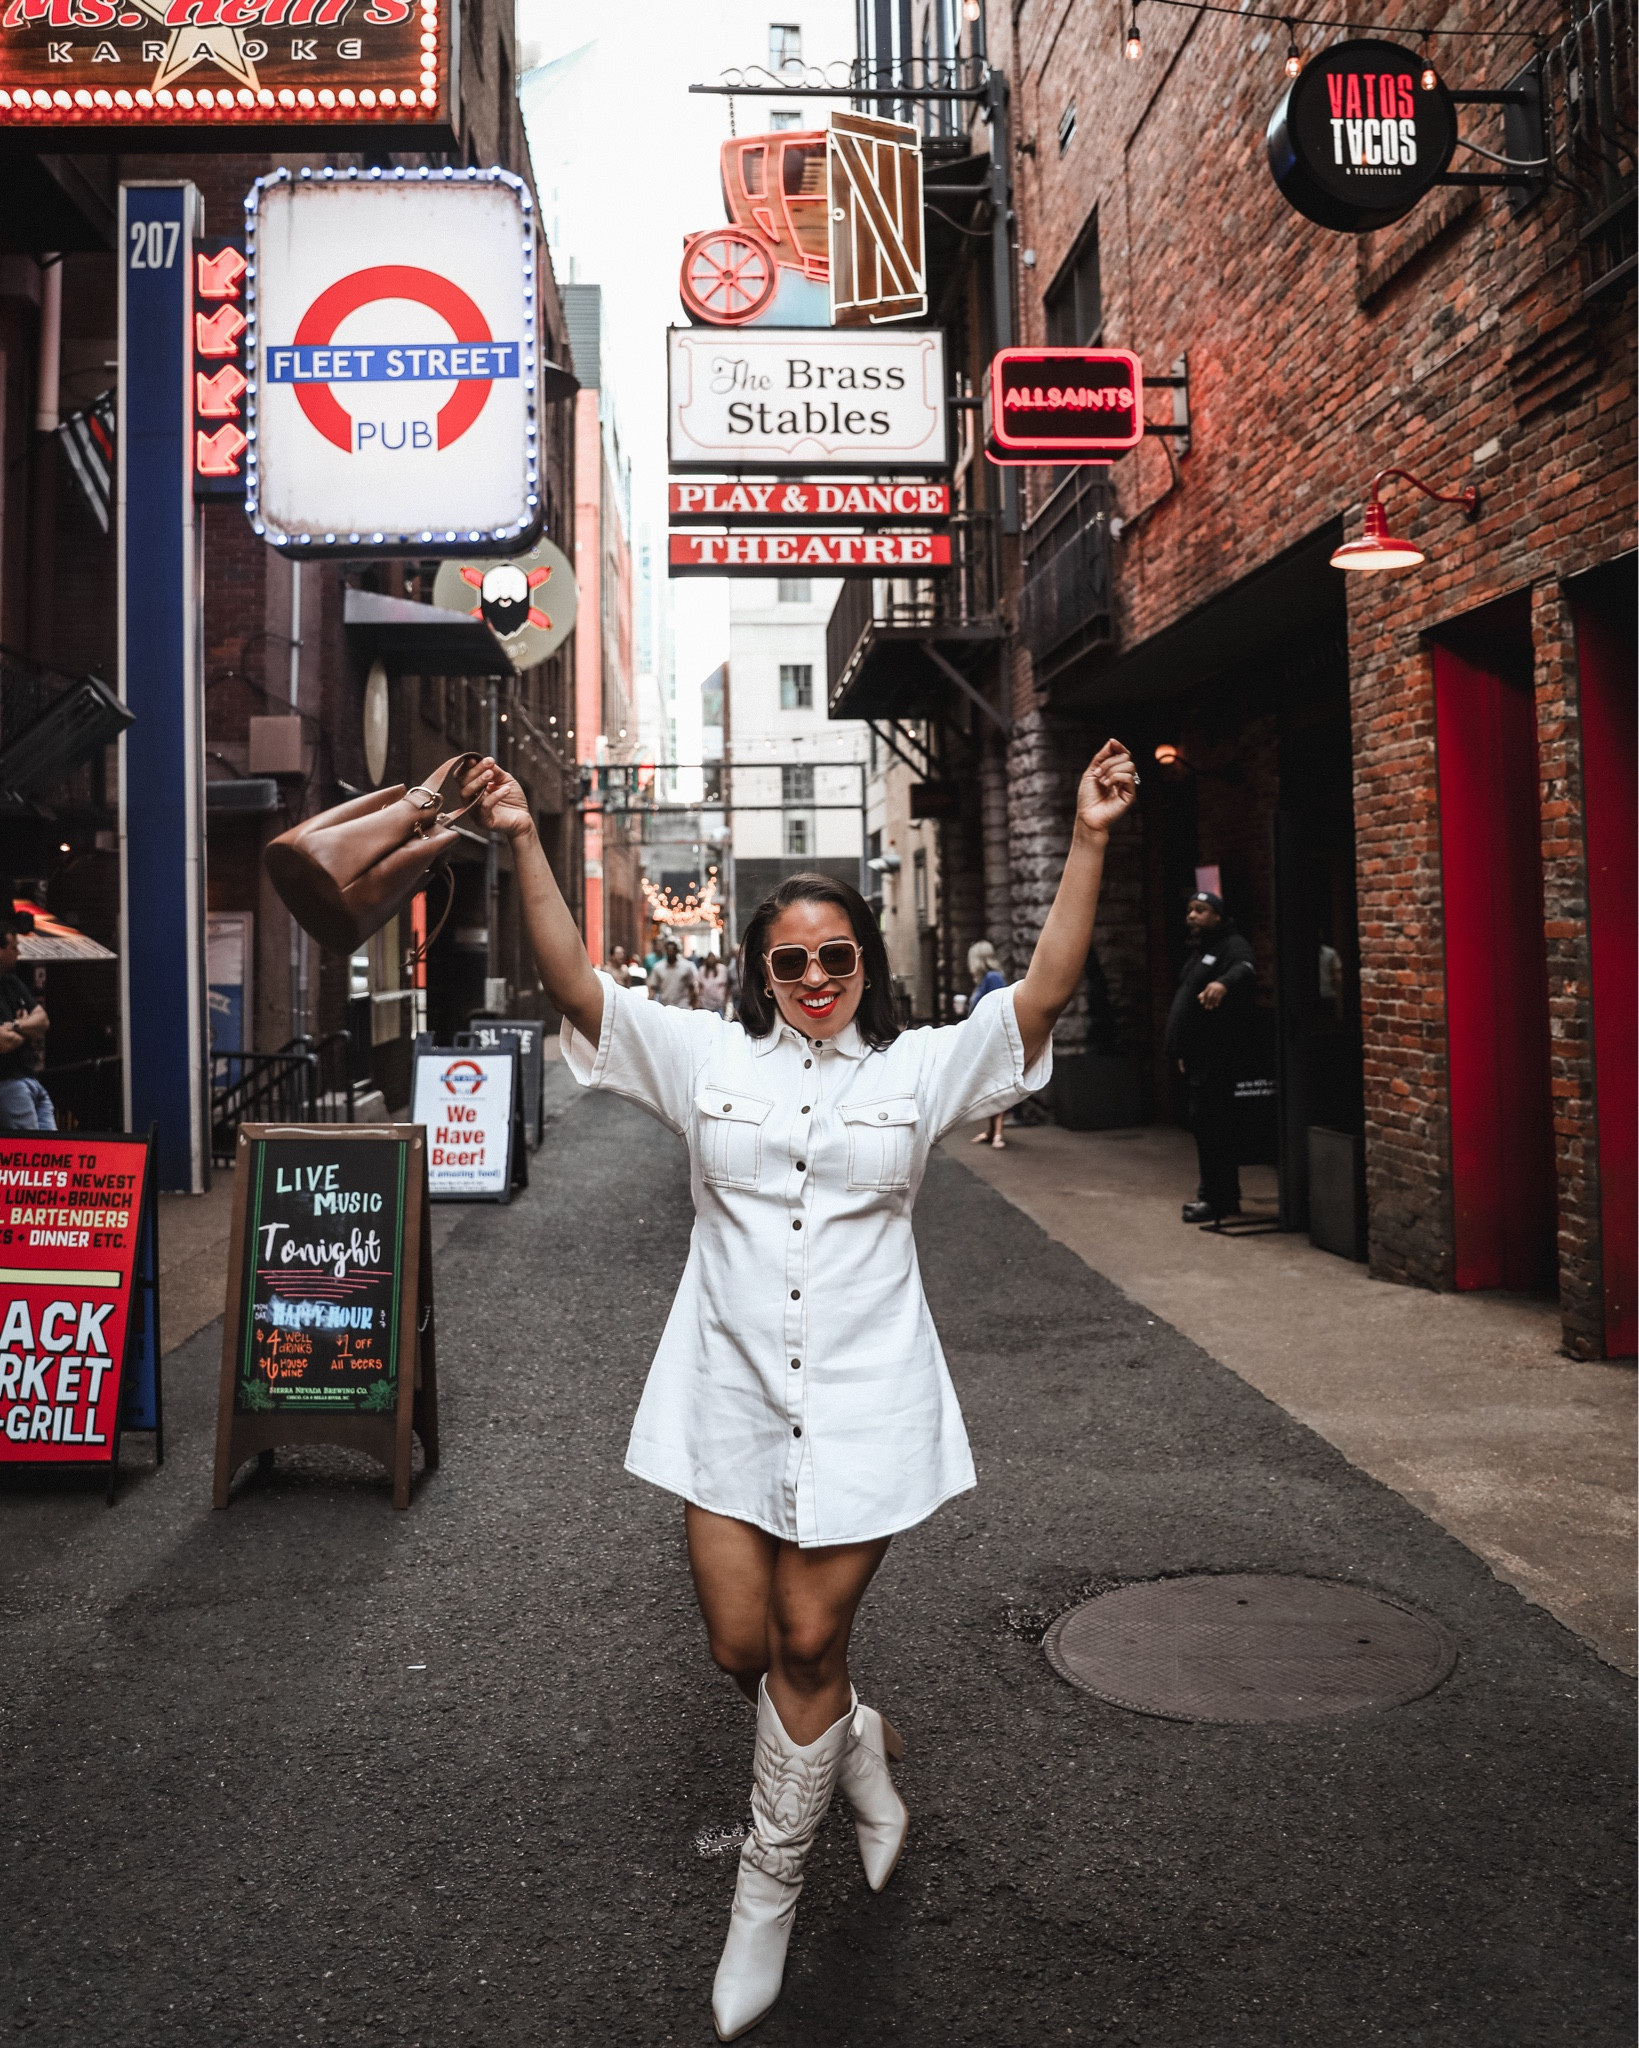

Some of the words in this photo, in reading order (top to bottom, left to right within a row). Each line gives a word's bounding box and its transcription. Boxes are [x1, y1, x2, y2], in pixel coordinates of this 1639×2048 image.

[48, 39, 362, 63] KARAOKE
[1326, 73, 1415, 119] VATOS
[1330, 118, 1417, 166] TACOS
[130, 221, 181, 269] 207
[273, 351, 376, 379] FLEET
[385, 347, 513, 378] STREET
[709, 356, 773, 395] The
[785, 358, 905, 390] Brass
[1003, 386, 1134, 410] ALLSAINTS
[727, 402, 891, 435] Stables
[357, 421, 433, 450] PUB
[677, 485, 775, 513] PLAY
[780, 485, 809, 513] &
[815, 485, 944, 514] DANCE
[690, 536, 933, 564] THEATRE
[447, 1104, 477, 1123] We
[435, 1126, 486, 1145] Have
[0, 1152, 73, 1169] WELCOME
[78, 1155, 97, 1169] TO
[432, 1148, 486, 1166] Beer!
[71, 1173, 136, 1189] NEWEST
[276, 1163, 340, 1193] LIVE
[5, 1189, 59, 1206] LUNCH
[67, 1191, 133, 1208] BRUNCH
[313, 1191, 383, 1216] MUSIC
[10, 1207, 130, 1229] BARTENDERS
[29, 1229, 90, 1247] DINNER
[93, 1233, 127, 1249] ETC.
[258, 1222, 381, 1278] Tonight
[0, 1299, 115, 1353] ACK
[355, 1338, 373, 1349] OFF
[0, 1352, 112, 1402] RKET
[295, 1387, 322, 1395] NEVADA
[323, 1387, 355, 1395] BREWING
